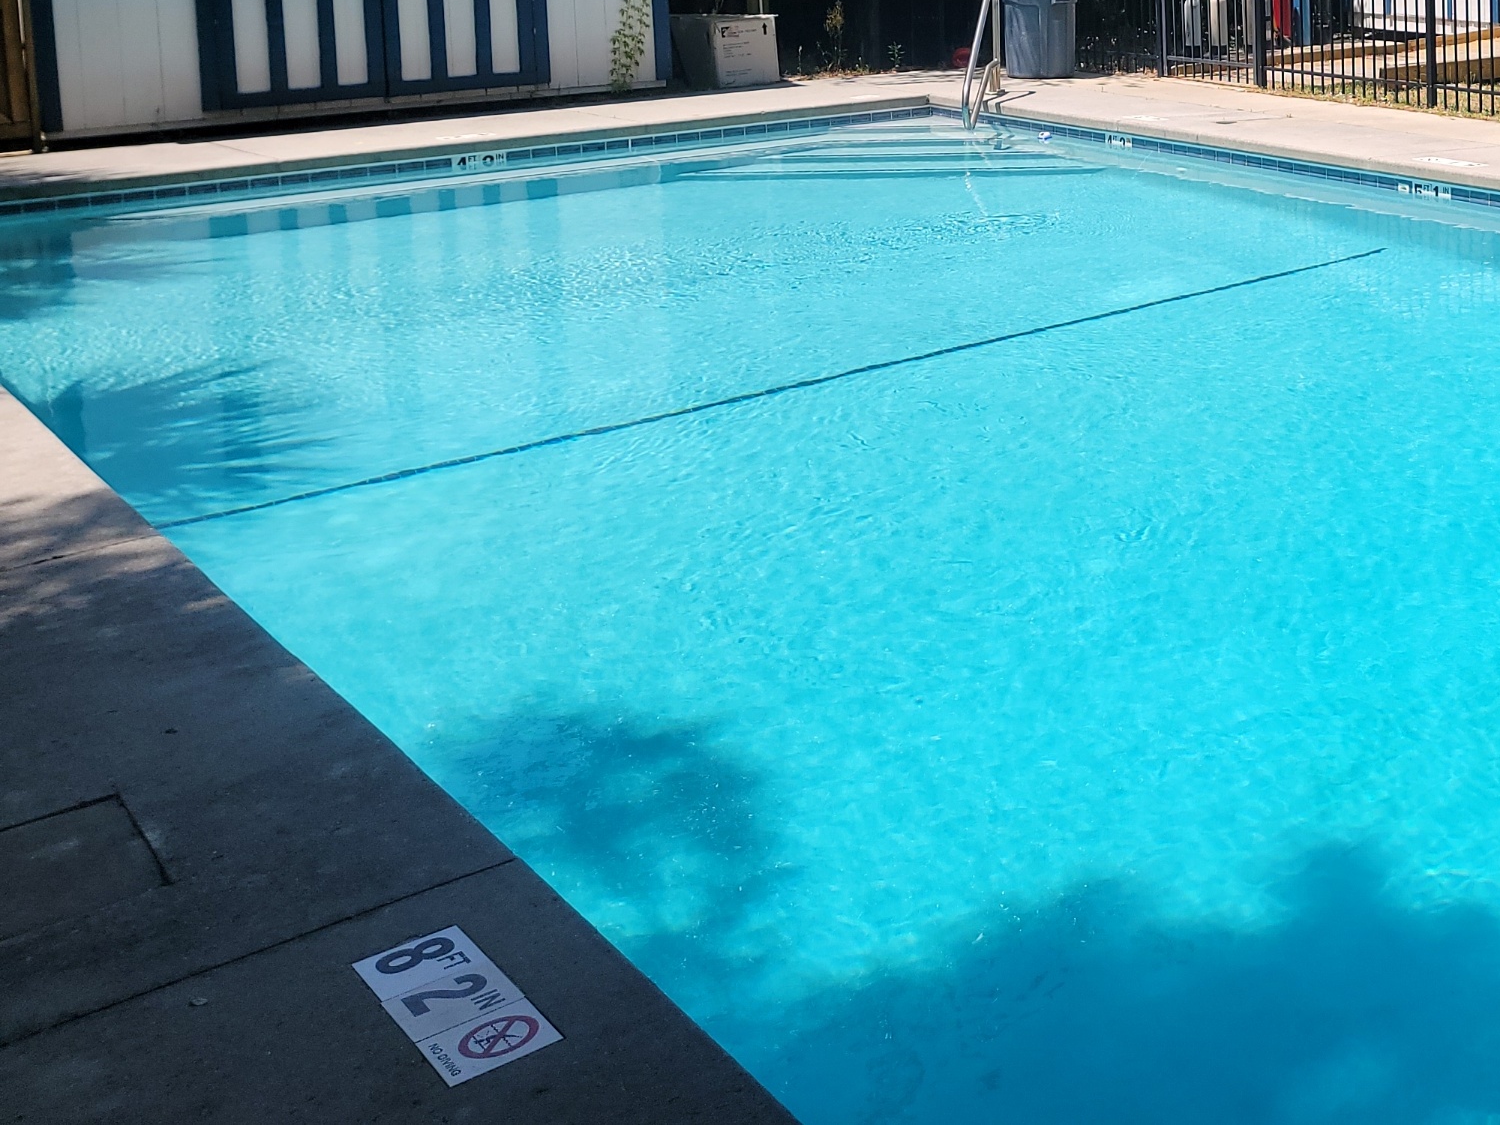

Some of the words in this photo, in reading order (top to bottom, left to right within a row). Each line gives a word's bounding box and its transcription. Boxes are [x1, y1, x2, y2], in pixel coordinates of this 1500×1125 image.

[468, 155, 477, 163] FT
[495, 153, 504, 161] IN
[1433, 185, 1439, 197] 1
[1443, 186, 1450, 195] IN
[375, 936, 456, 975] 8
[436, 950, 472, 970] FT
[400, 973, 488, 1018] 2
[470, 988, 506, 1011] IN
[428, 1042, 444, 1055] NO
[437, 1053, 462, 1077] DIVING
